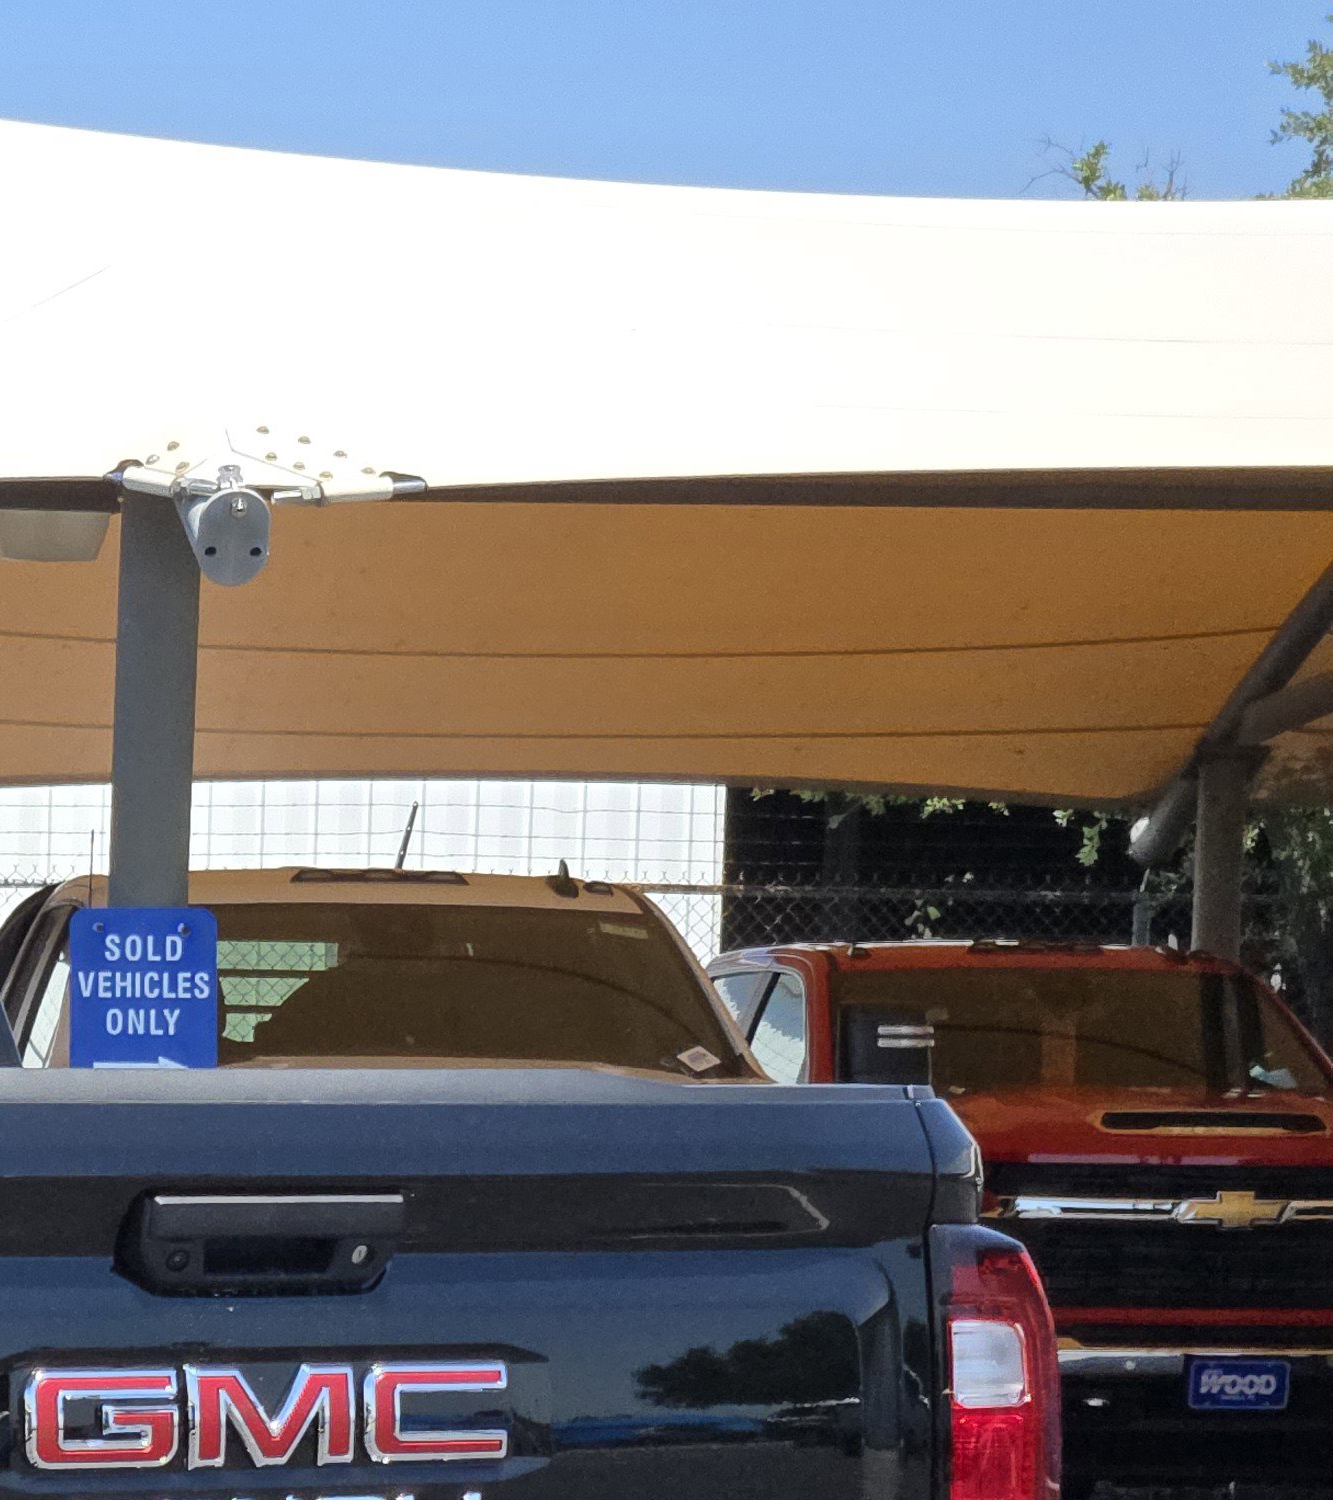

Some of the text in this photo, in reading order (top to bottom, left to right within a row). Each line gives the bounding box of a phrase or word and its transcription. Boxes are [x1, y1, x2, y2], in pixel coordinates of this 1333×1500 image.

[104, 934, 183, 962] SOLD
[78, 971, 210, 999] VEHICLES
[106, 1008, 180, 1036] ONLY
[24, 1360, 509, 1470] GMC
